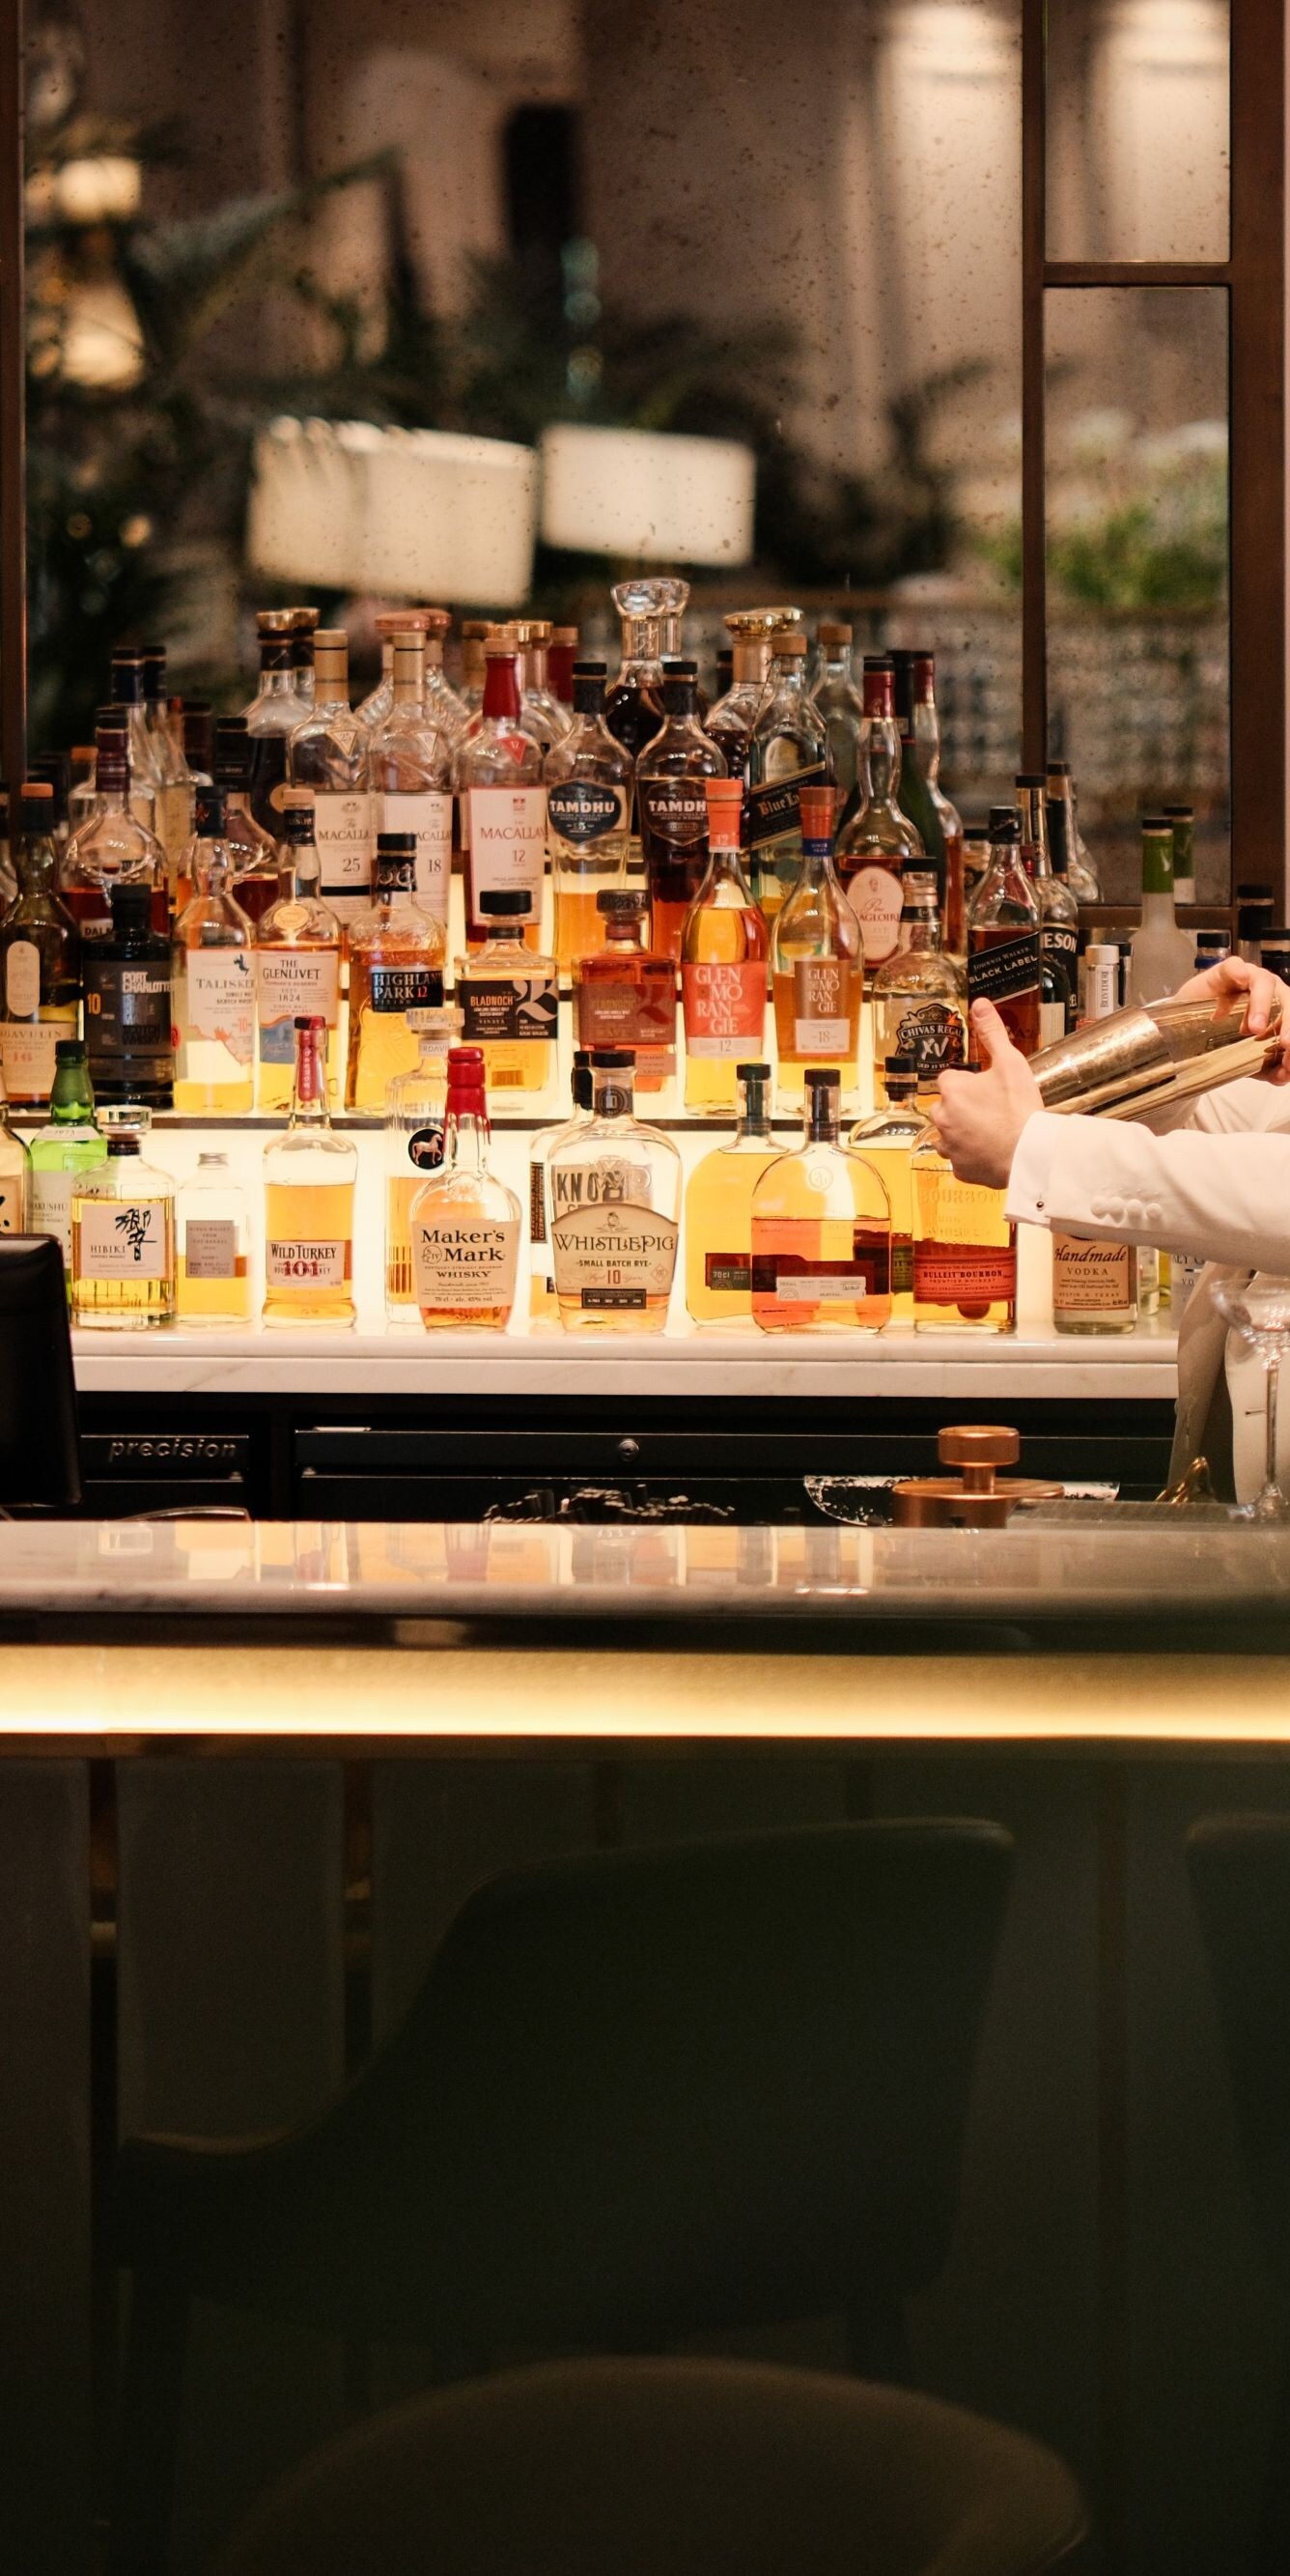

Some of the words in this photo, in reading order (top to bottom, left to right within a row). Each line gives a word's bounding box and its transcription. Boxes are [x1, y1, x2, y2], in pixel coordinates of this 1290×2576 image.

[549, 800, 615, 813] TAMDHU
[757, 800, 786, 818] Blue
[513, 849, 526, 863] 12
[342, 857, 361, 872] 25
[427, 859, 442, 873] 18
[1044, 932, 1077, 953] ESON
[280, 959, 298, 968] THE
[968, 967, 1002, 984] BLACK
[1004, 954, 1038, 972] LABEL
[122, 971, 149, 983] PORT
[263, 968, 322, 980] GLENLIVET
[695, 966, 742, 984] GLEN
[807, 968, 839, 980] GLEN
[819, 978, 840, 991] MO
[279, 994, 300, 1003] 1824
[374, 985, 414, 1000] PARK
[417, 984, 428, 998] 12
[710, 983, 743, 1002] MO
[810, 990, 833, 1003] RAN
[88, 992, 101, 1015] 10
[470, 995, 514, 1006] BLADNOCH
[818, 1002, 837, 1013] GIE
[696, 1001, 732, 1019] RAN
[711, 1017, 740, 1035] GIE
[901, 1025, 936, 1039] CHIVAS
[818, 1030, 830, 1043] 18
[719, 1039, 732, 1052] 12
[920, 1036, 949, 1061] XV
[421, 1229, 505, 1244] Maker's
[553, 1233, 675, 1254] WHISTLEPIG
[90, 1245, 126, 1254] HIBIKI
[270, 1243, 295, 1260] WILD
[295, 1244, 337, 1260] TURKEY
[443, 1247, 504, 1262] Mark
[1054, 1244, 1127, 1262] Handmade
[283, 1260, 319, 1277] 101
[606, 1260, 631, 1268] BATCH
[1067, 1266, 1108, 1276] VODKA
[436, 1270, 491, 1279] WHISKY
[607, 1269, 621, 1285] 10
[108, 1437, 237, 1462] precision
